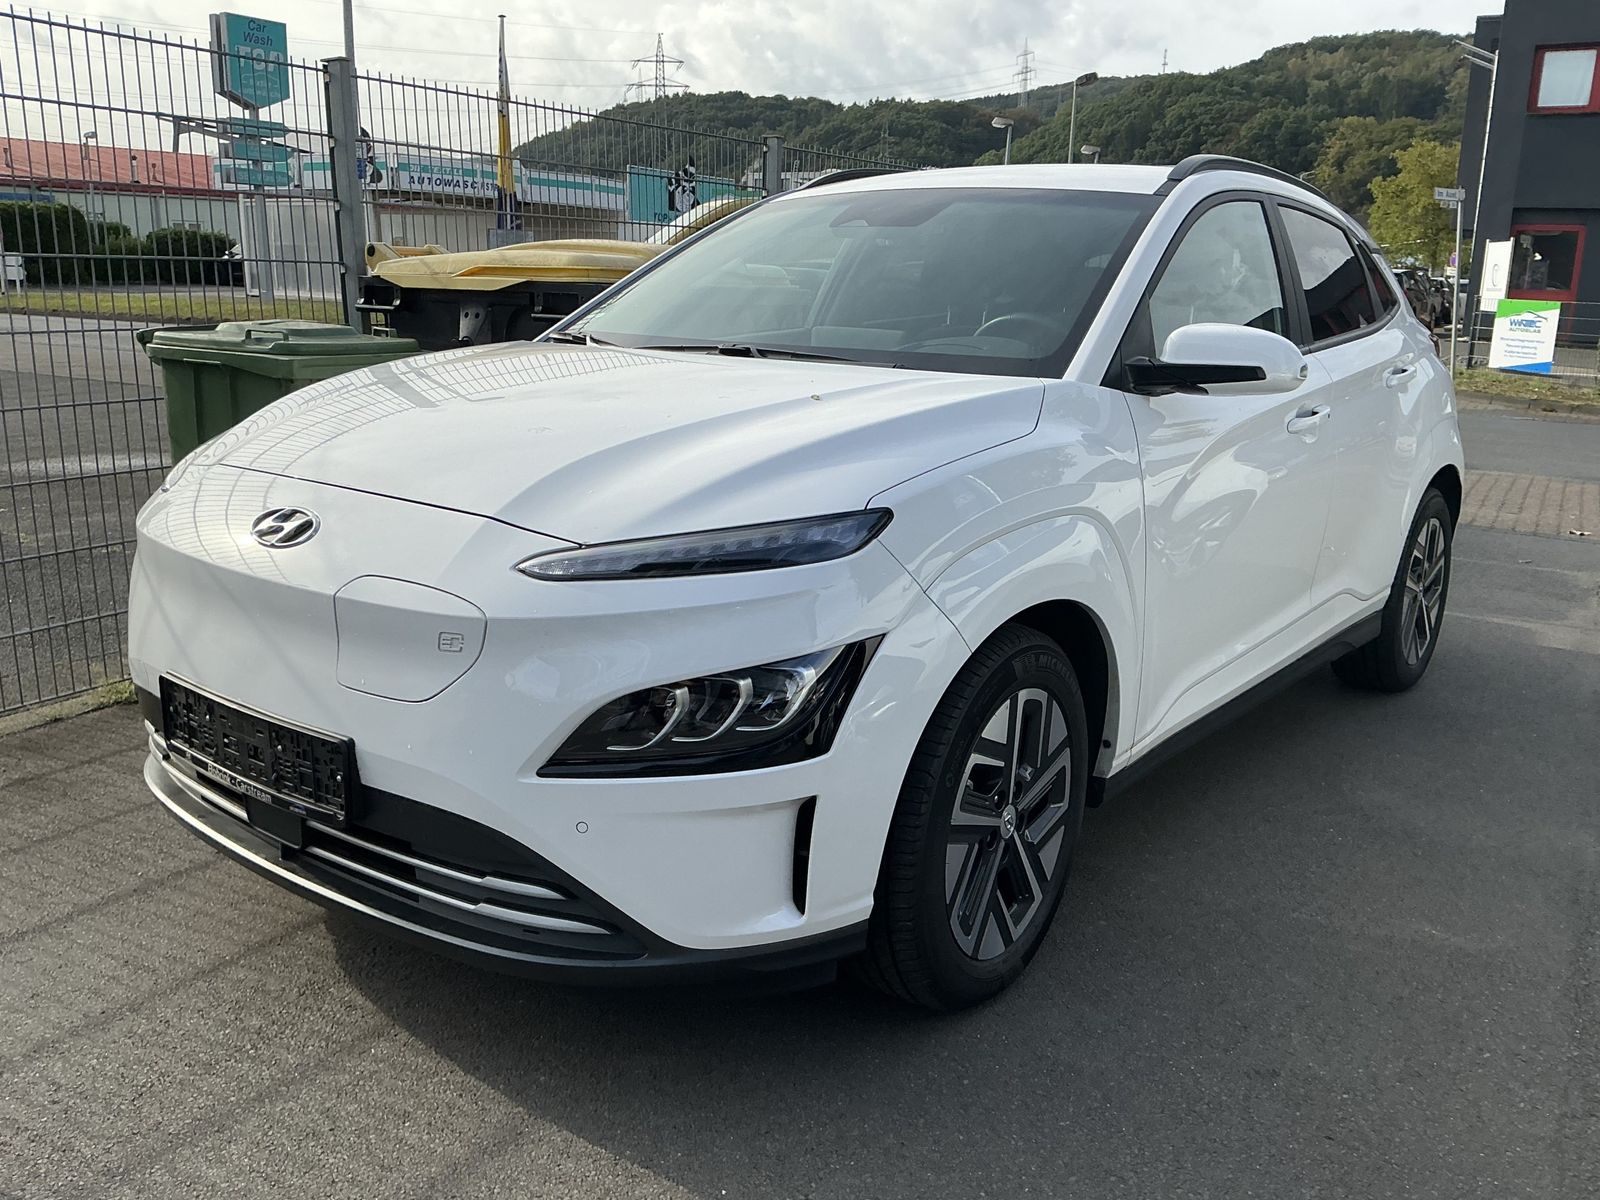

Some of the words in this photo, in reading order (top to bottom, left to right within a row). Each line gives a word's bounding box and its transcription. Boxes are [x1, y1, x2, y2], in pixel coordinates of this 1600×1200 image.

[247, 19, 267, 34] Car
[243, 31, 273, 47] Wash
[235, 778, 272, 804] Carstream
